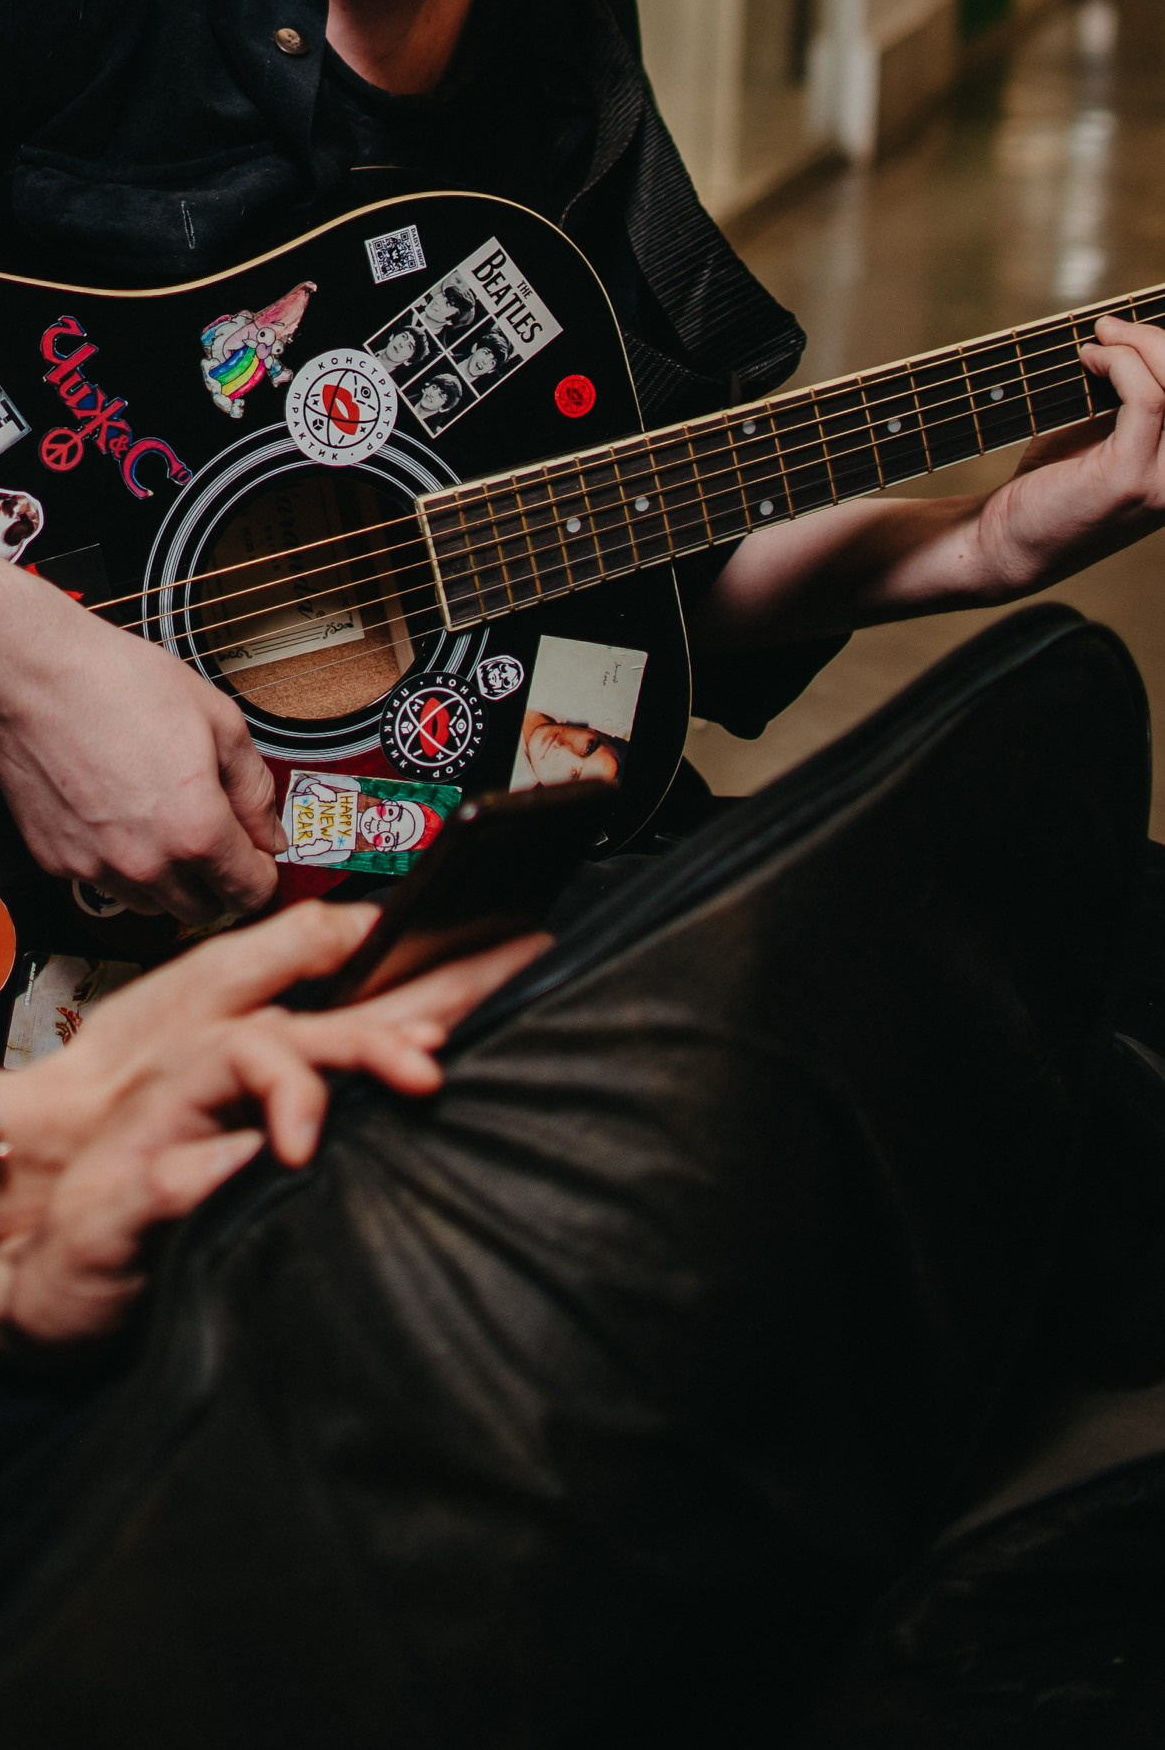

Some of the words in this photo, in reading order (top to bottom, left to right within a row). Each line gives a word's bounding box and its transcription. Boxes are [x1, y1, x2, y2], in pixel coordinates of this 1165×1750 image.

[410, 228, 420, 248] DAISY
[416, 249, 425, 267] SHOP
[471, 248, 543, 343] BEATLES
[517, 280, 533, 299] THE
[292, 392, 338, 460] ПРАКТИК
[318, 357, 392, 450] КОНСТРУКТОР
[384, 688, 409, 768] ПРАКТИК
[433, 676, 483, 778] КОНСТРУКТОР
[318, 802, 335, 838] NEW
[337, 795, 352, 838] HAPPY
